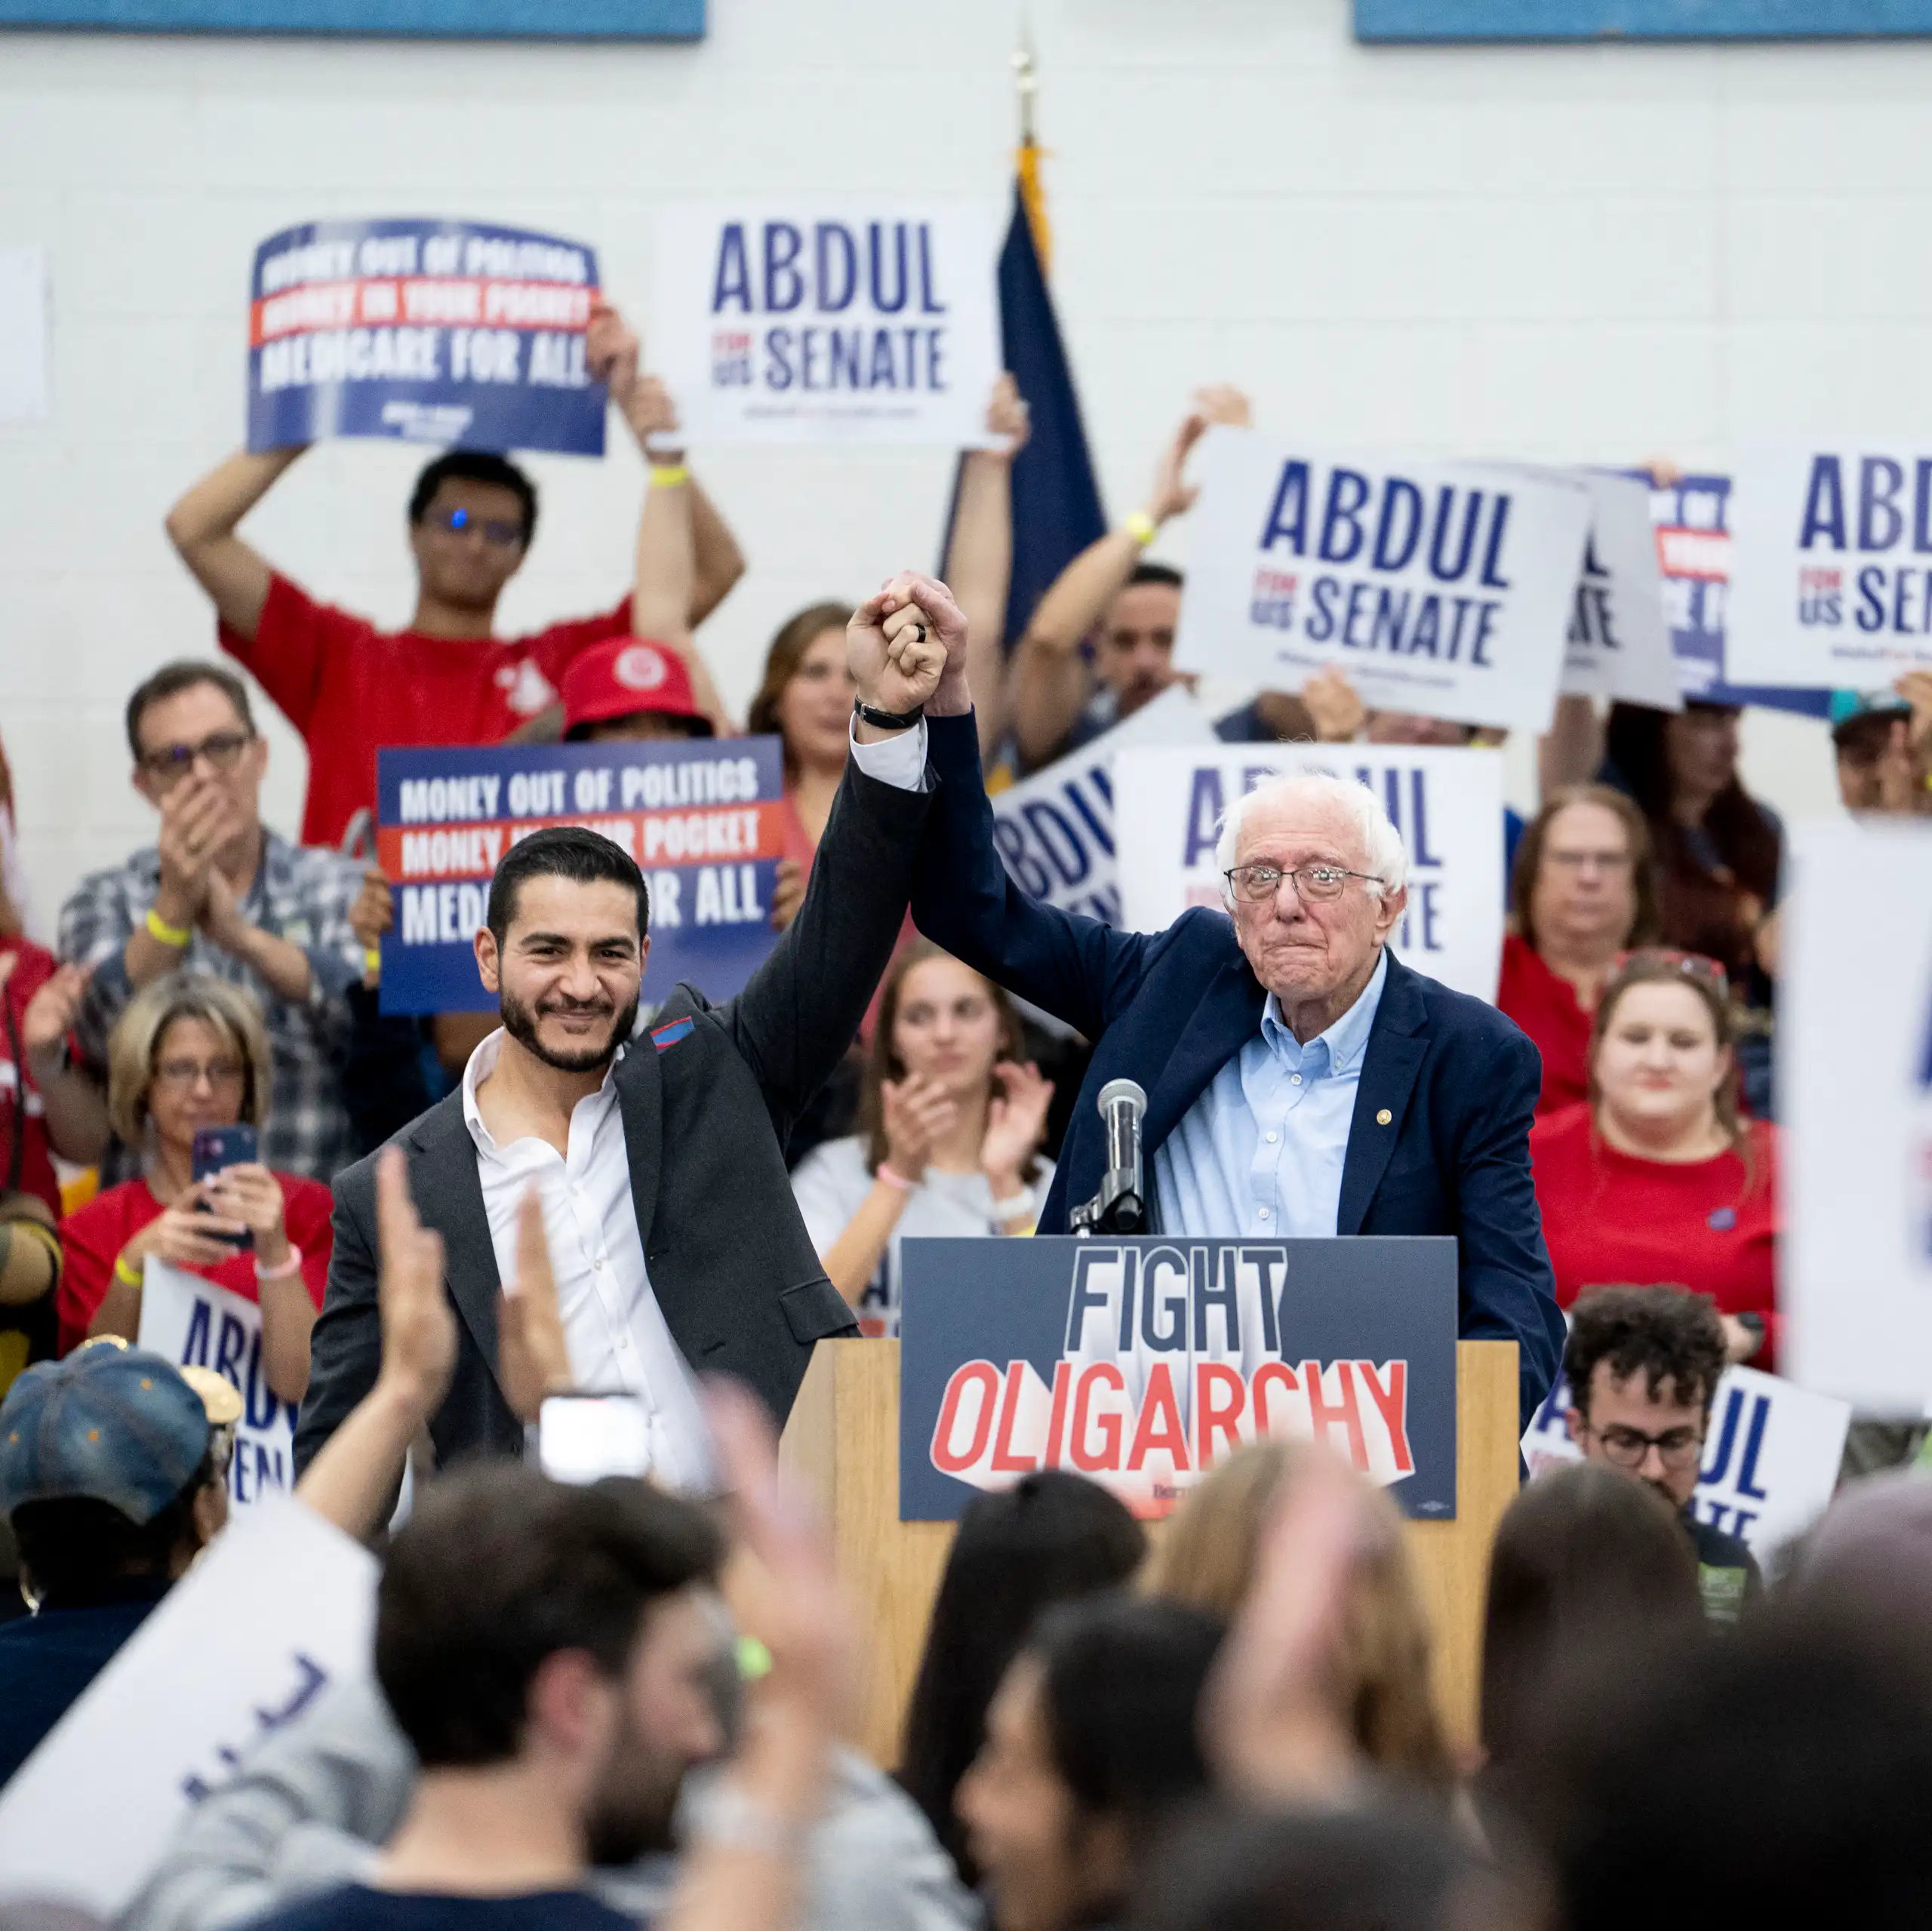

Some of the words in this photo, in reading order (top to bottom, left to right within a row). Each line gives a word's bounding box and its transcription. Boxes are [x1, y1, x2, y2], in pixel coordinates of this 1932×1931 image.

[711, 220, 948, 314] ABDUL
[261, 326, 441, 394] MEDICARE
[450, 331, 521, 384] FOR
[530, 332, 591, 388] ALL
[764, 325, 948, 392] SENATE
[1259, 457, 1512, 590] ABDUL
[1303, 575, 1504, 668] SENATE
[1798, 596, 1843, 628] US
[399, 775, 500, 824] MONEY
[508, 770, 568, 816] OUT
[574, 766, 614, 813] OF
[621, 756, 758, 808] POLITICS
[401, 826, 503, 878] MONEY
[644, 809, 761, 866] POCKET
[694, 863, 765, 926] ALL
[1063, 1246, 1289, 1354] FIGHT
[930, 1359, 1416, 1475] OLIGARCHY
